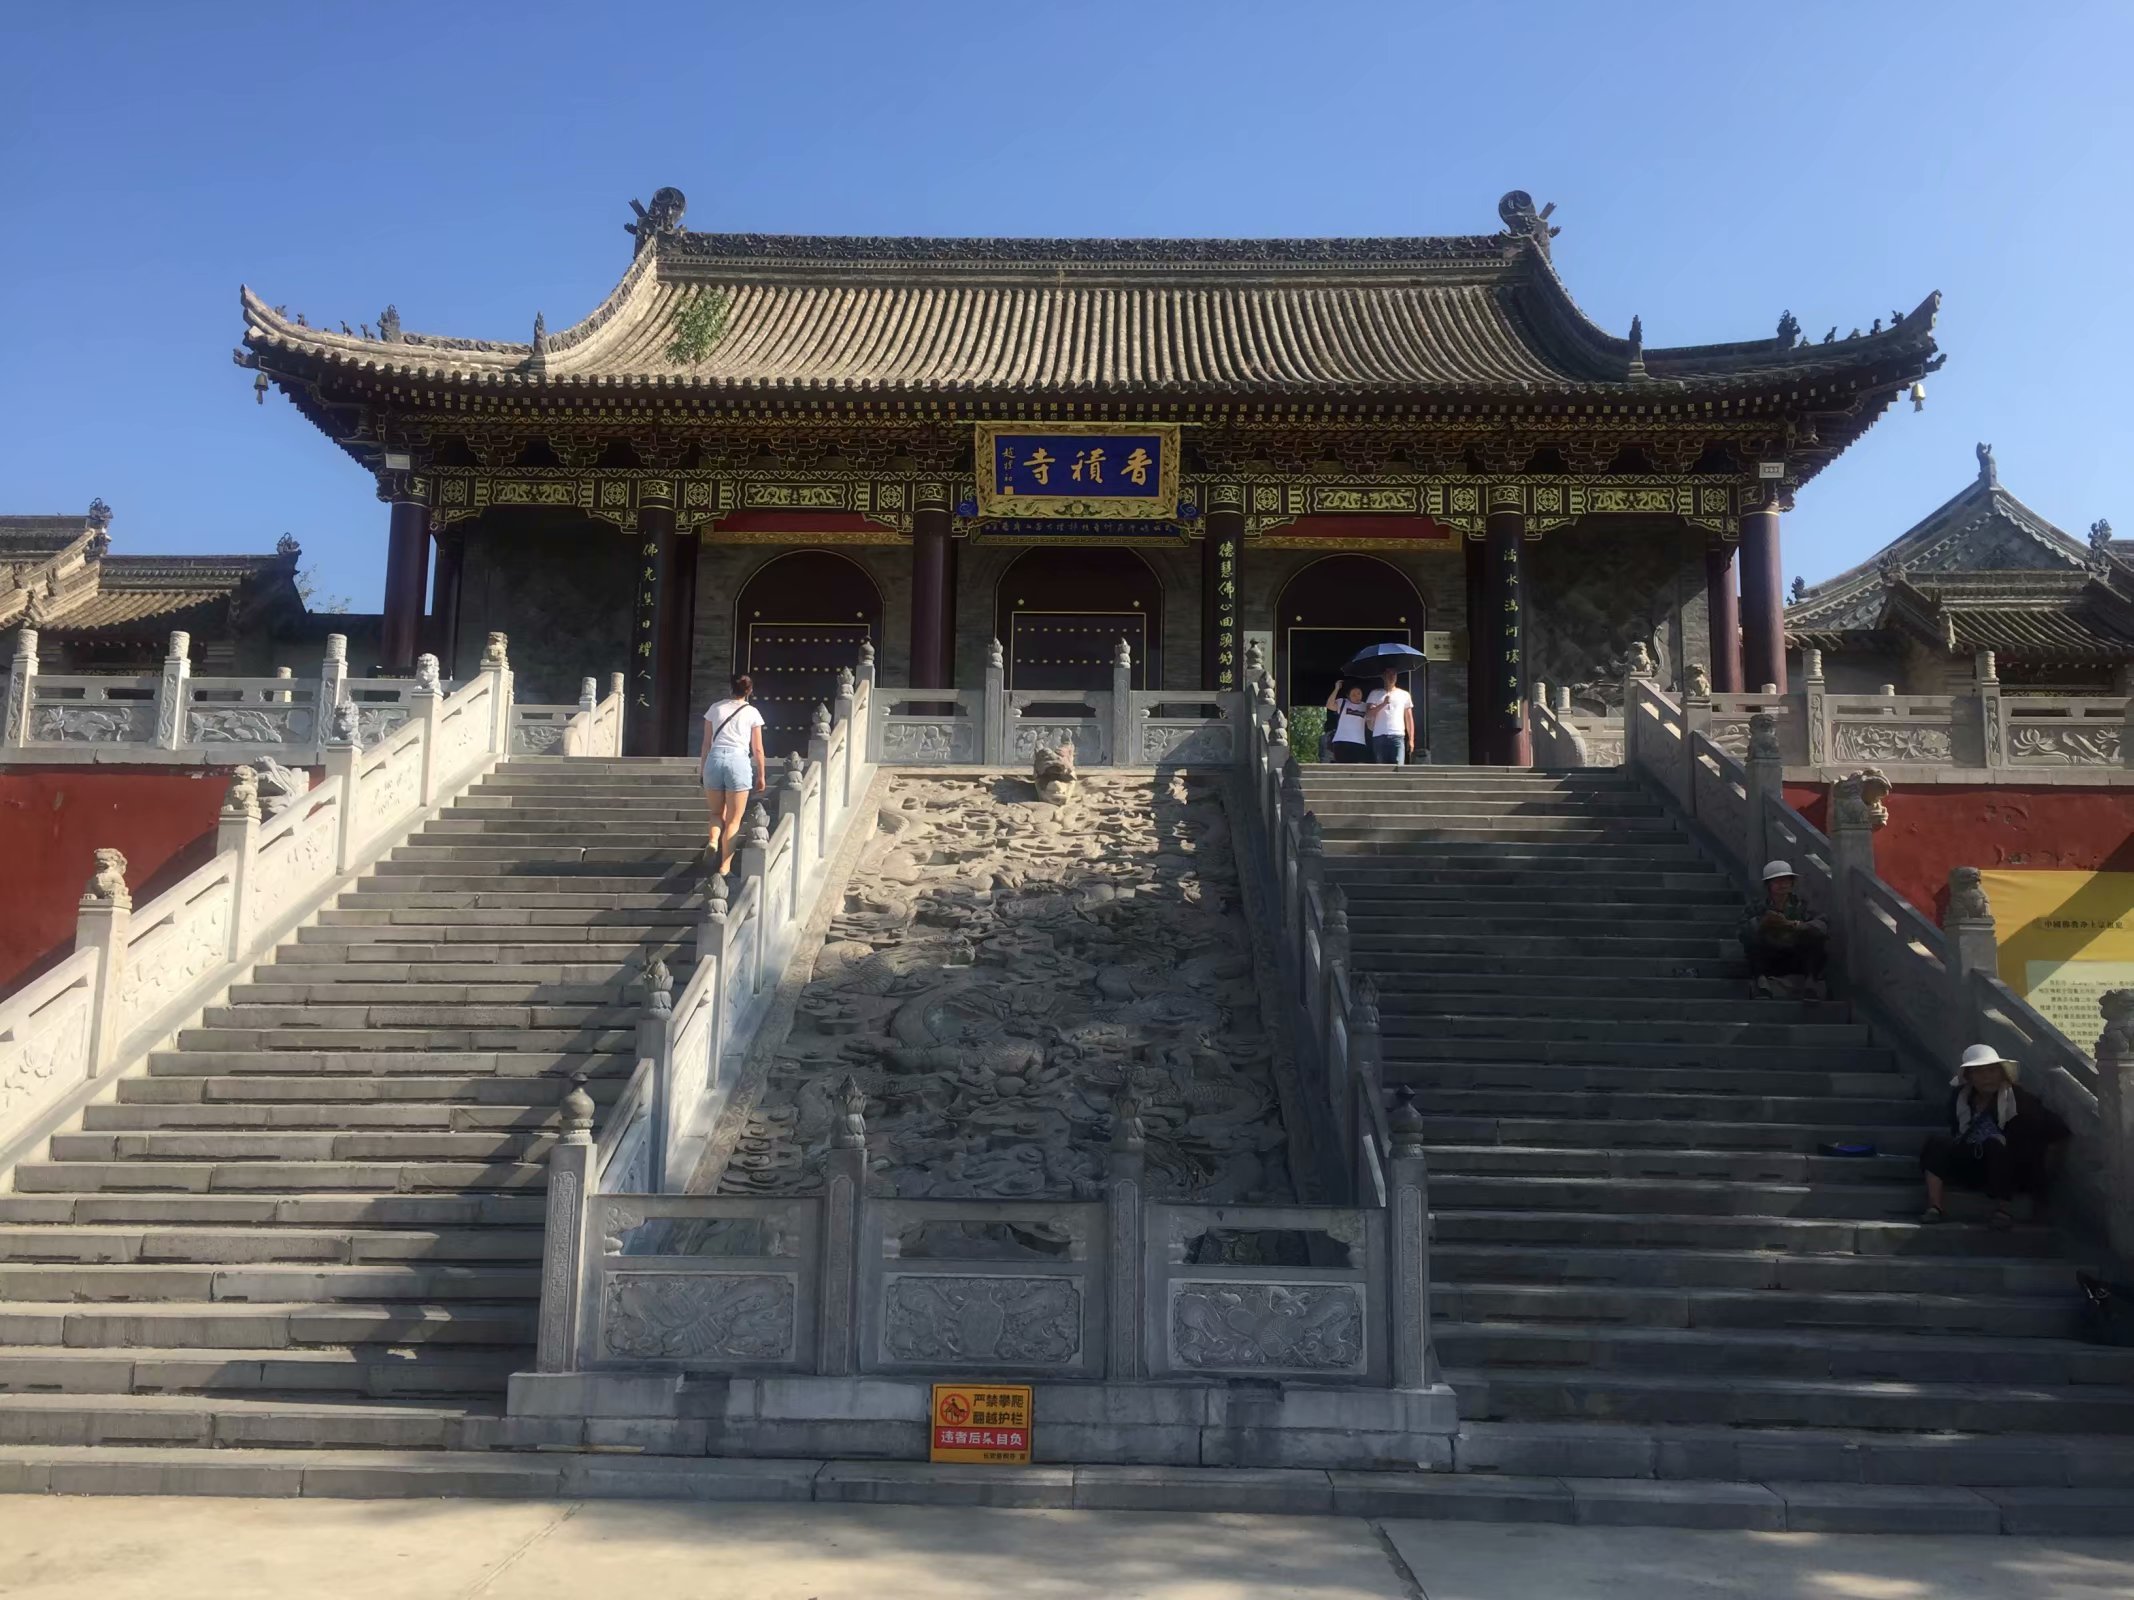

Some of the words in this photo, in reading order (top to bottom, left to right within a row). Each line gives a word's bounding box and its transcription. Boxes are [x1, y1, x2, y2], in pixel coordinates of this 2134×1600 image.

[1023, 447, 1153, 486] 香積寺
[973, 1393, 1024, 1408] 严禁攀爬
[973, 1411, 1024, 1425] 翻越护栏
[940, 1430, 1023, 1446] 违者后果自负
